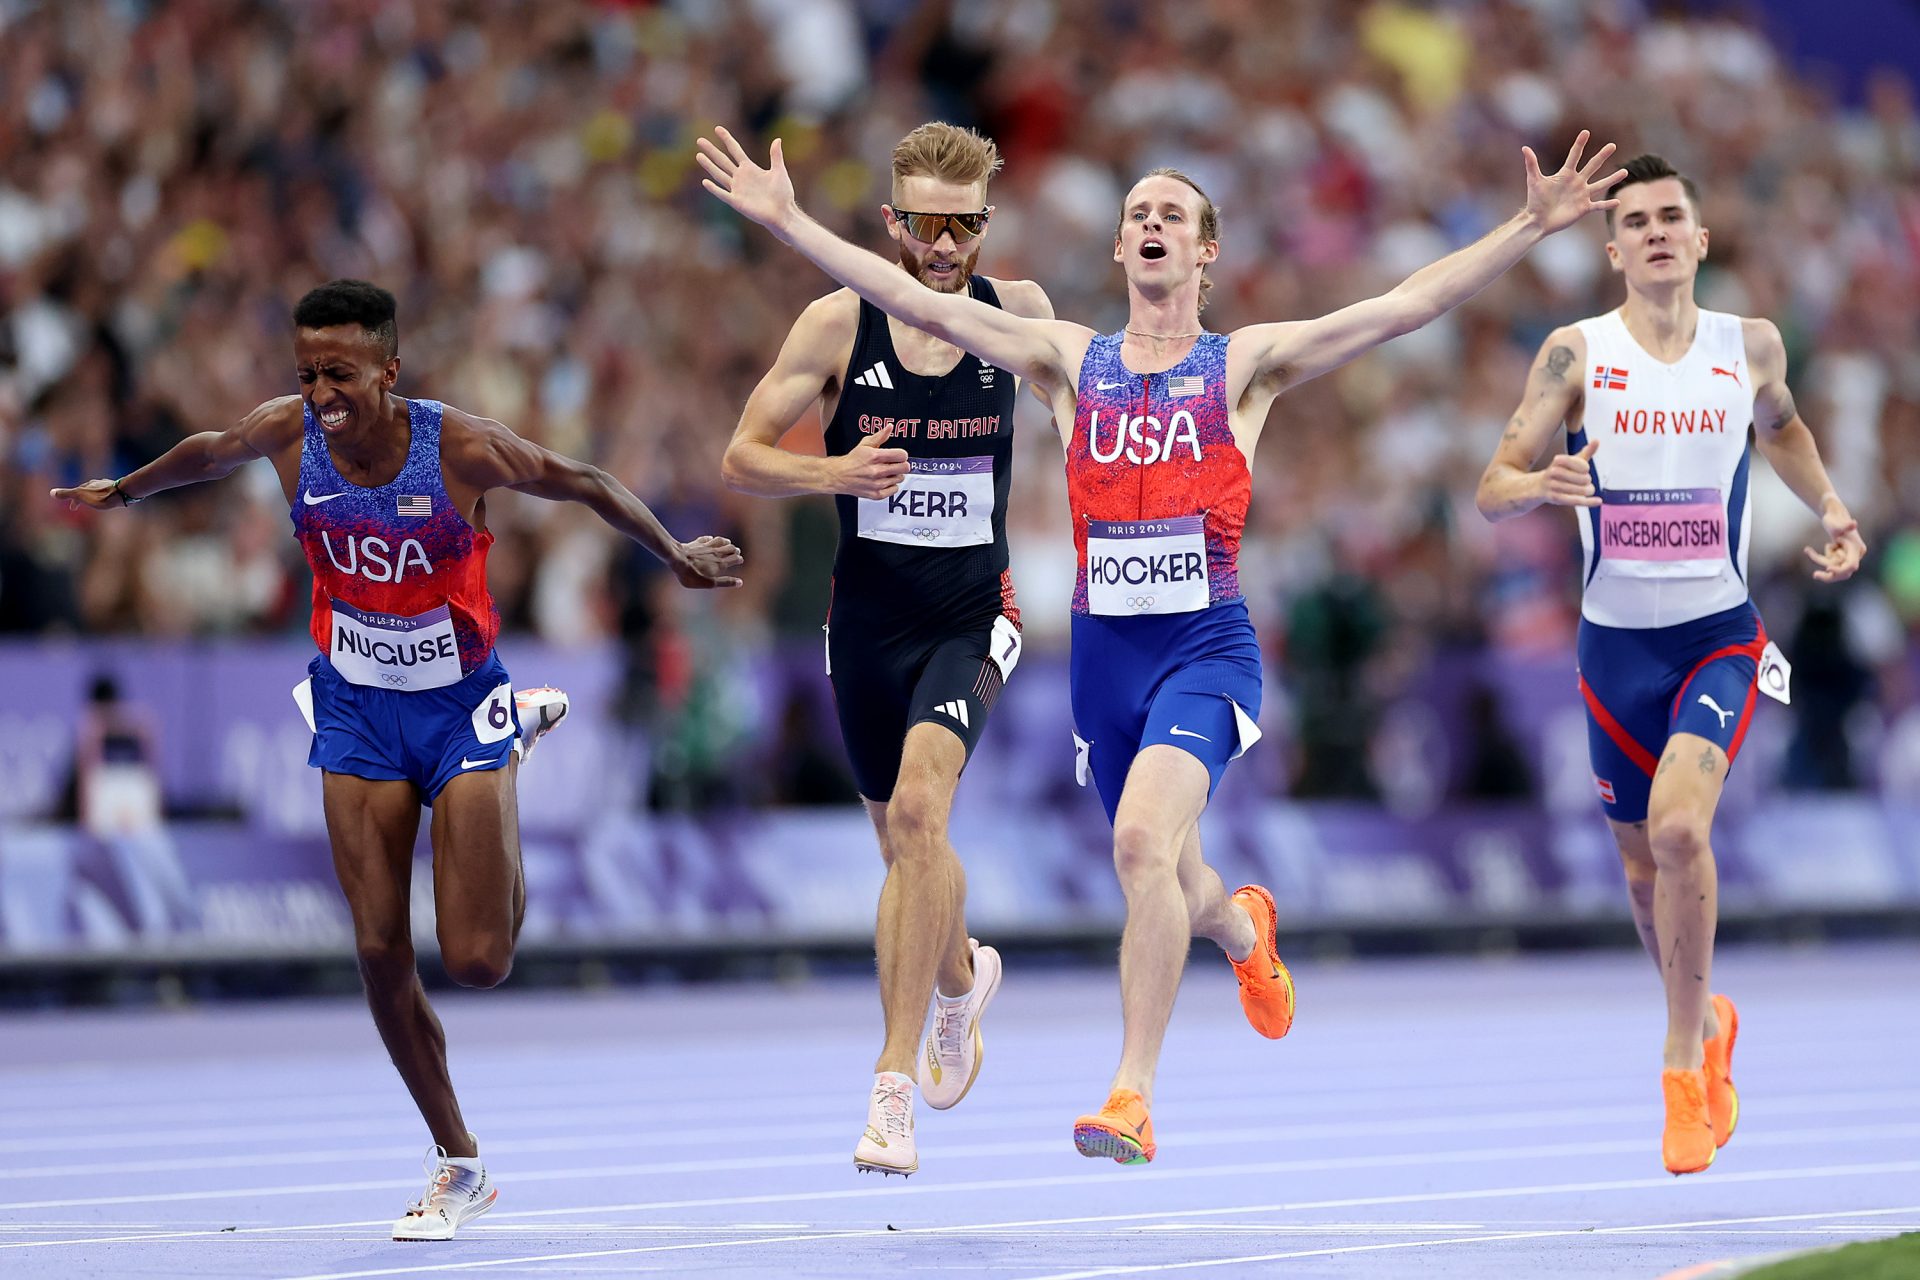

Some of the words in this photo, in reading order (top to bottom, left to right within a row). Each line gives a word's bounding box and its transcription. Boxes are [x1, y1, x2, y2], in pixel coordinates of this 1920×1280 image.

[858, 414, 921, 438] GREAT
[927, 415, 1000, 439] BRITAIN
[1614, 409, 1726, 434] NORWAY
[1090, 410, 1203, 465] USA
[932, 462, 962, 471] 2024
[888, 490, 968, 517] KERR
[1629, 492, 1661, 501] PARIS
[1664, 492, 1693, 501] 2024
[1107, 525, 1136, 535] PARIS
[1139, 525, 1171, 534] 2024
[1604, 519, 1721, 548] INGEBRIGTSEN
[321, 531, 433, 583] USA
[1091, 552, 1204, 585] HOCKER
[357, 613, 386, 625] PARIS
[389, 618, 418, 629] 2024
[337, 626, 455, 666] NUGUSE
[487, 698, 508, 730] 6
